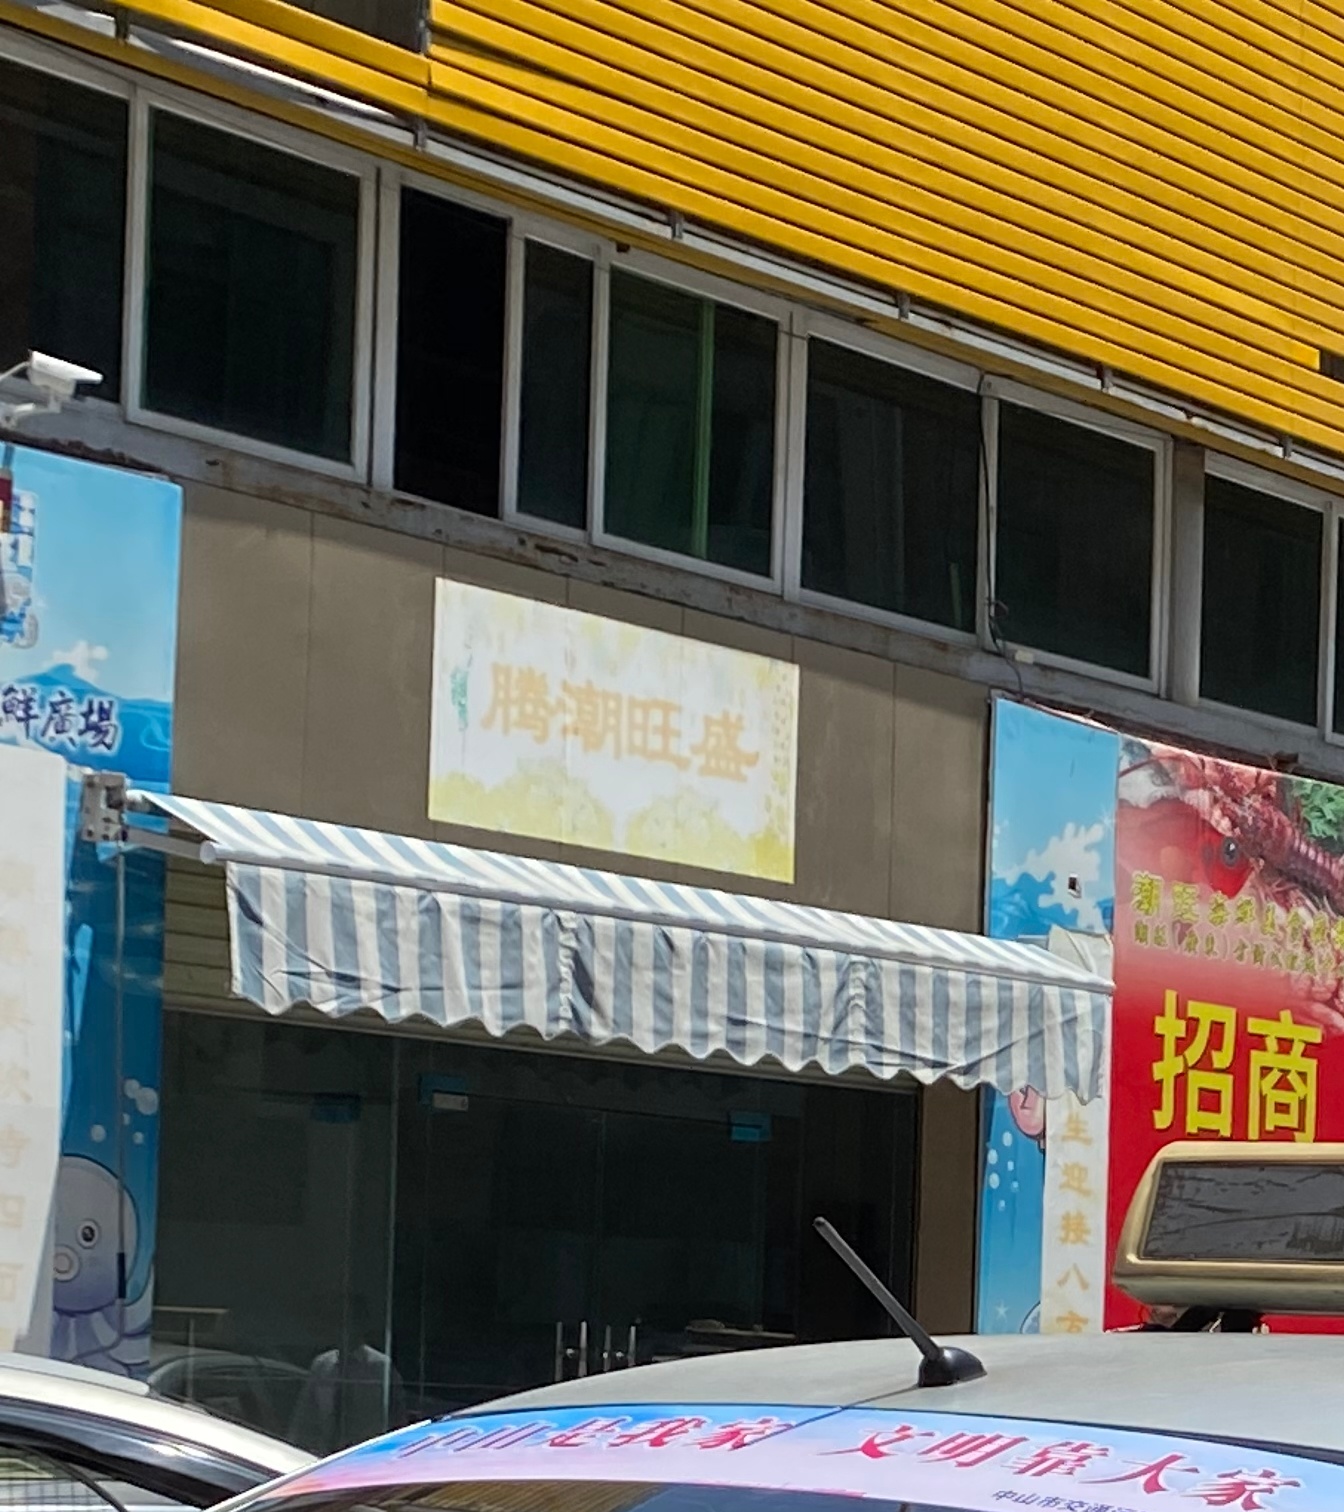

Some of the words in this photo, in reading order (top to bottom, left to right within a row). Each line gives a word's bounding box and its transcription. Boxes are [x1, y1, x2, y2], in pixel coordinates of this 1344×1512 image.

[1153, 990, 1324, 1143] 招商
[396, 1416, 797, 1460] 中山是我家
[817, 1425, 1300, 1511] 文明靠大家
